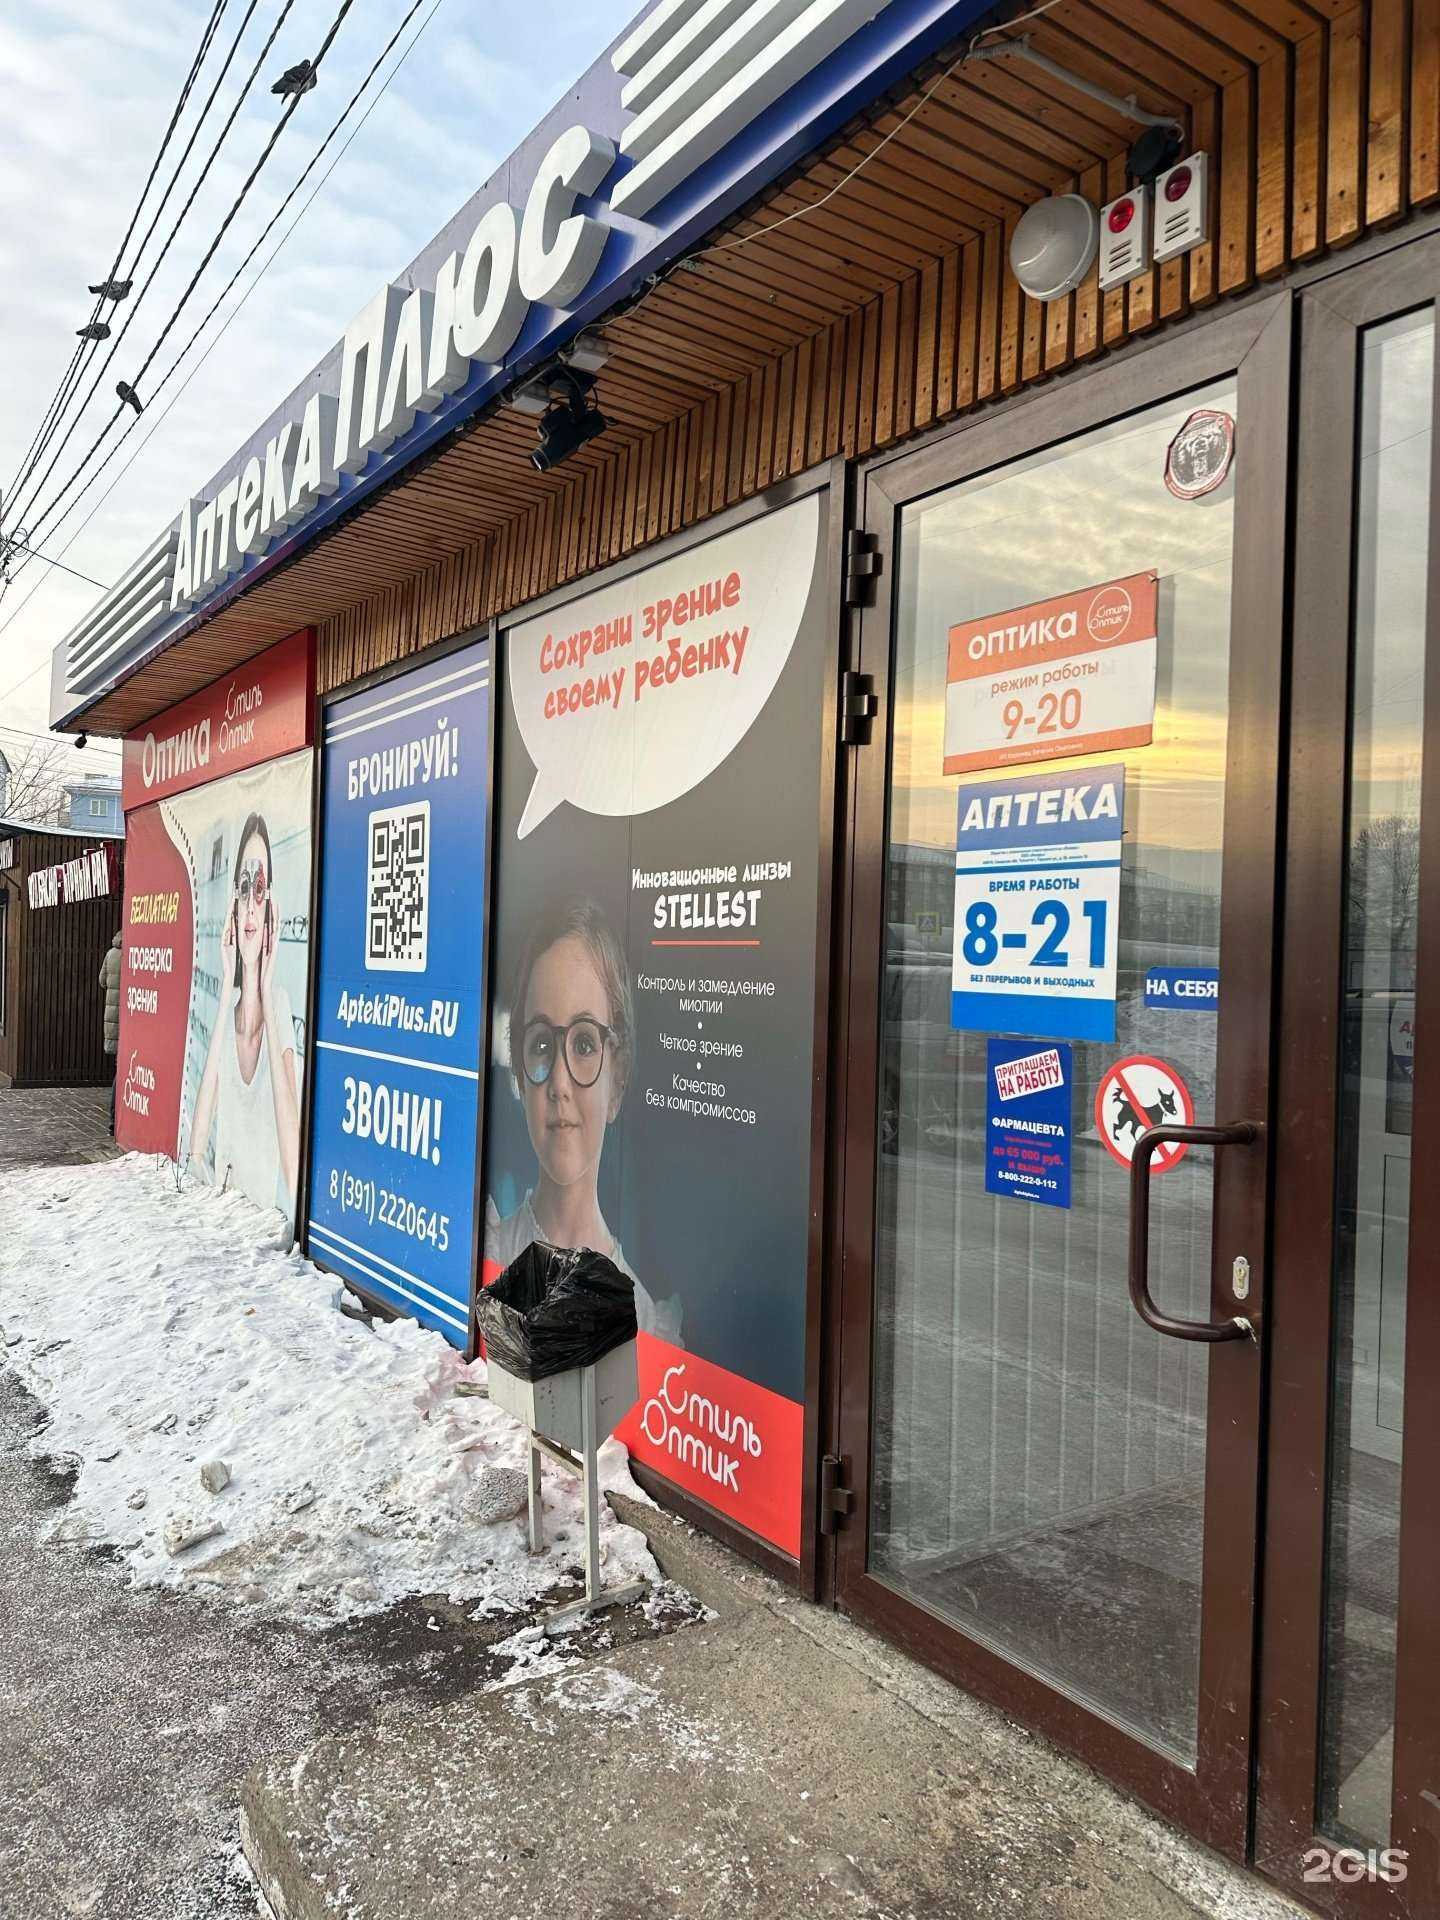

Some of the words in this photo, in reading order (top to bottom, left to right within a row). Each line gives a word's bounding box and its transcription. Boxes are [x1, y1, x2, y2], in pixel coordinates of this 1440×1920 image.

[540, 614, 633, 674] Сохрани
[642, 570, 742, 642] зрение
[544, 667, 626, 720] своему
[635, 625, 750, 702] ребенку
[991, 673, 1039, 698] режим
[1042, 660, 1099, 687] работы
[225, 680, 263, 720] Стиль
[1003, 688, 1082, 740] 9-20
[143, 718, 210, 788] Оптика
[217, 718, 255, 754] Оптик
[348, 717, 458, 800] БРОНИРУЙ!
[961, 783, 1119, 831] АПТЕКА
[632, 864, 737, 890] Инновационные
[742, 861, 792, 884] линзы
[989, 880, 1025, 893] ВРЕМЯ
[1029, 878, 1080, 891] РАБОТЫ
[130, 892, 179, 925] БЕСПЛАТНАЯ
[653, 889, 761, 929] STELLEST
[963, 900, 1107, 969] 8-21
[128, 946, 172, 978] проверка
[637, 974, 687, 995] Контроль
[688, 980, 696, 992] и
[698, 976, 776, 996] замедление
[970, 974, 984, 983] БЕЗ
[985, 975, 1032, 985] ПЕРЕРЫВОВ
[1034, 977, 1040, 985] И
[1043, 977, 1096, 988] ВЫХОДНЫХ
[1146, 979, 1169, 996] НА
[1174, 980, 1218, 998] СЕБЯ
[127, 985, 158, 1016] зрения
[337, 990, 459, 1037] AptekiPlus.RU
[679, 997, 723, 1014] миопии
[659, 1032, 697, 1053] Четкое
[699, 1038, 743, 1058] зрение
[128, 1050, 155, 1091] Стиль
[997, 1052, 1058, 1080] ПРИГЛАШАЕМ
[1000, 1080, 1015, 1098] НА
[1017, 1065, 1060, 1094] РАБОТУ
[123, 1079, 149, 1116] Оптик
[672, 1073, 726, 1097] Качество
[342, 1076, 442, 1166] ЗВОНИ!
[645, 1088, 665, 1107] без
[667, 1094, 756, 1124] компромиссов
[992, 1117, 1065, 1137] ФАРМАЦЕВТА
[998, 1171, 1056, 1189] 8-800-222-0-112
[329, 1169, 338, 1198] 8
[341, 1170, 375, 1225] (391)
[378, 1189, 450, 1252] 2220645
[658, 1363, 762, 1458] Стиль
[640, 1398, 740, 1493] Оптик
